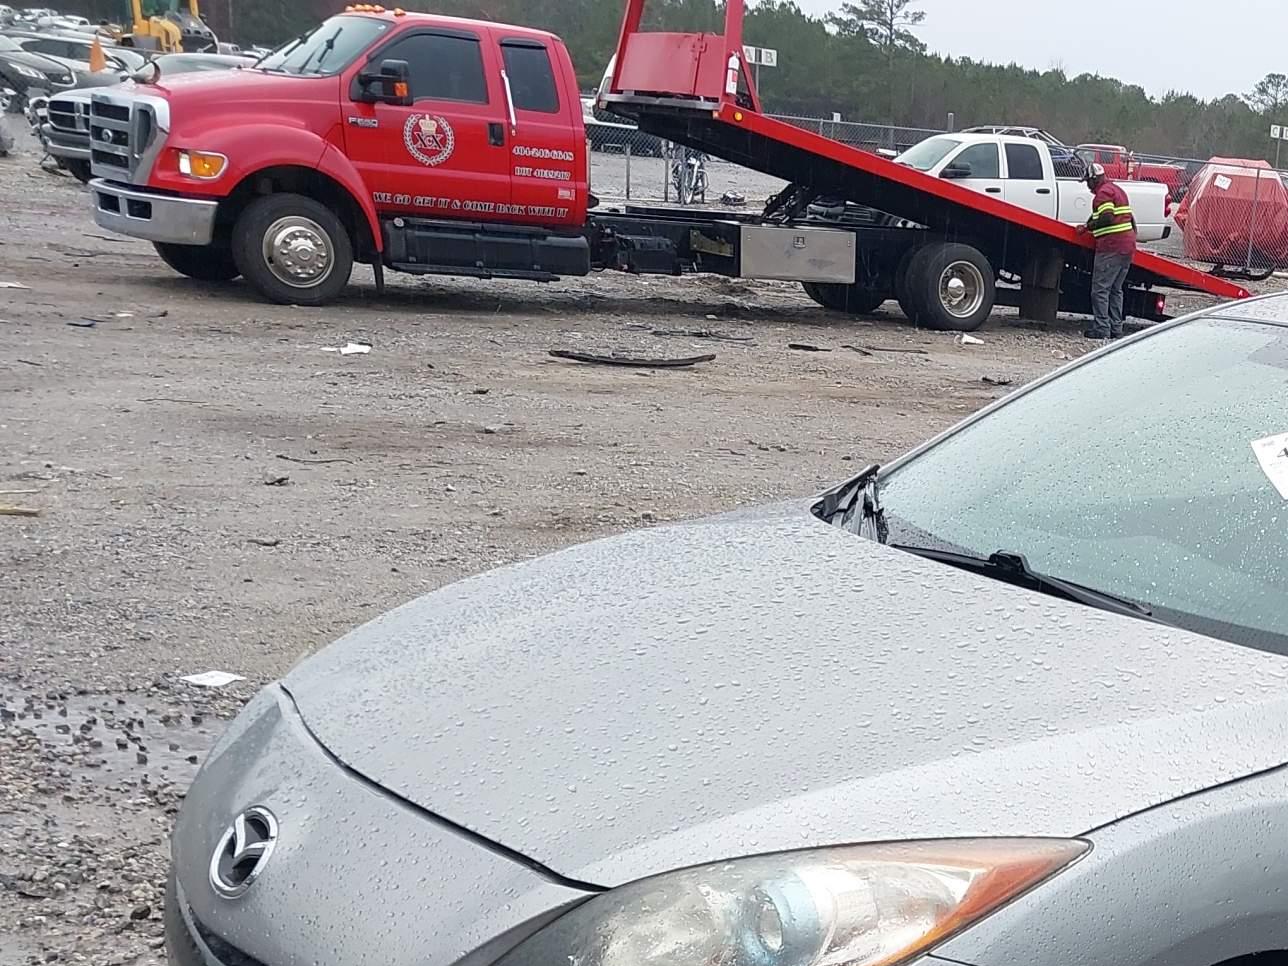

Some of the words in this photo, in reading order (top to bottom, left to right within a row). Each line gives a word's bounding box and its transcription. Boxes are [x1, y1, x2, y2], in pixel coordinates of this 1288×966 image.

[373, 191, 392, 203] WE
[393, 194, 411, 206] GO
[413, 195, 437, 208] GET
[437, 197, 451, 209] IT
[451, 199, 461, 210] &
[462, 200, 495, 213] COME
[496, 203, 527, 216] BACK
[527, 205, 555, 217] WITH
[556, 207, 569, 218] IT
